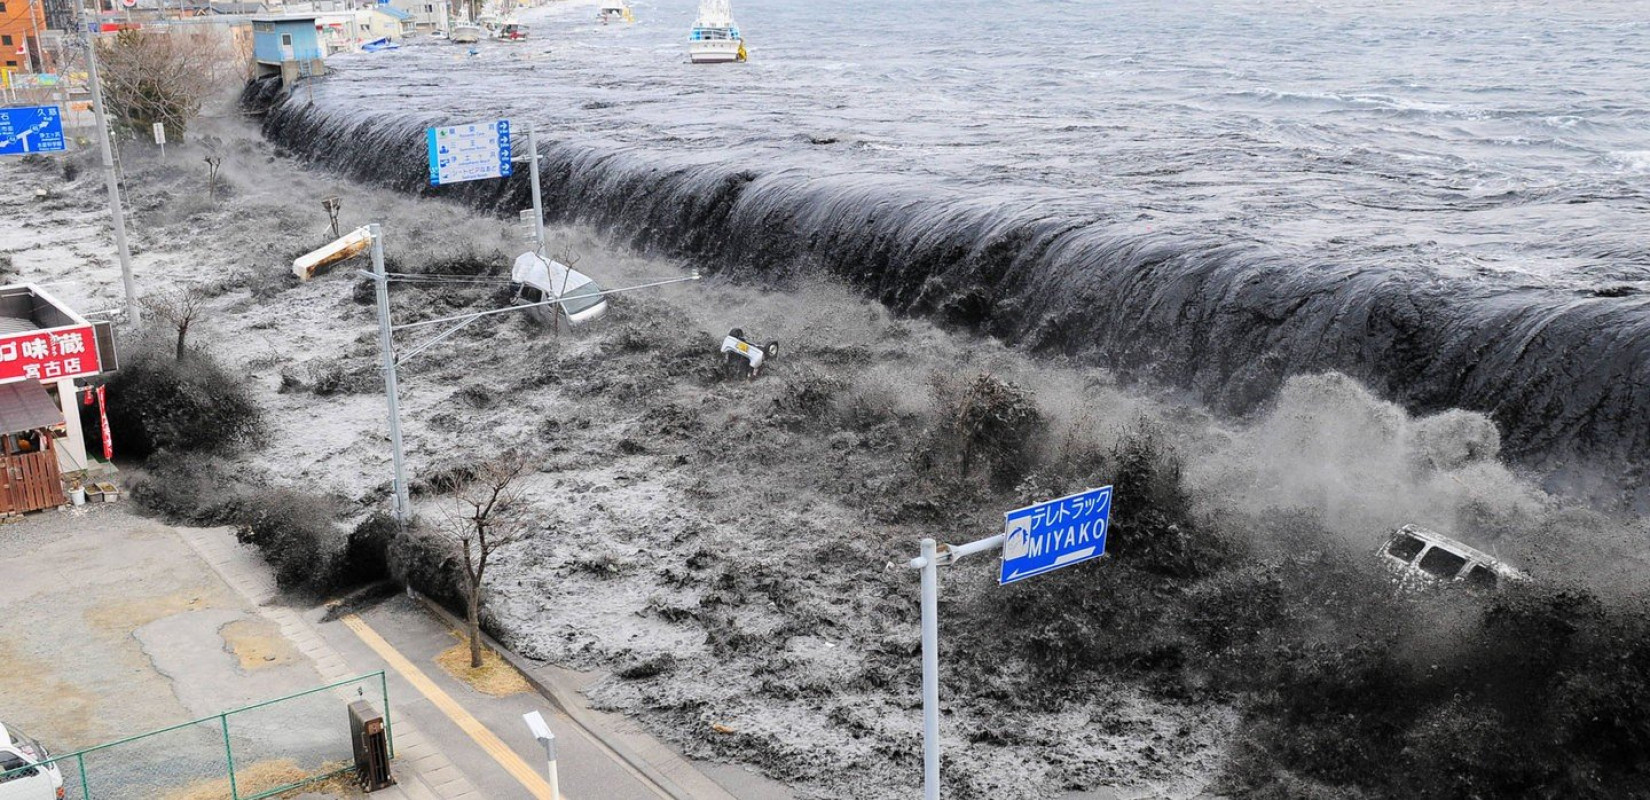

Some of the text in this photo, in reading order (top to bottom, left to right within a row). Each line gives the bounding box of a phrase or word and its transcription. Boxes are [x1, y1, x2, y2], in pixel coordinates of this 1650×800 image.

[23, 357, 81, 378] 宮古店
[1032, 491, 1109, 530] テレトラック
[1029, 518, 1104, 558] MIYAKO
